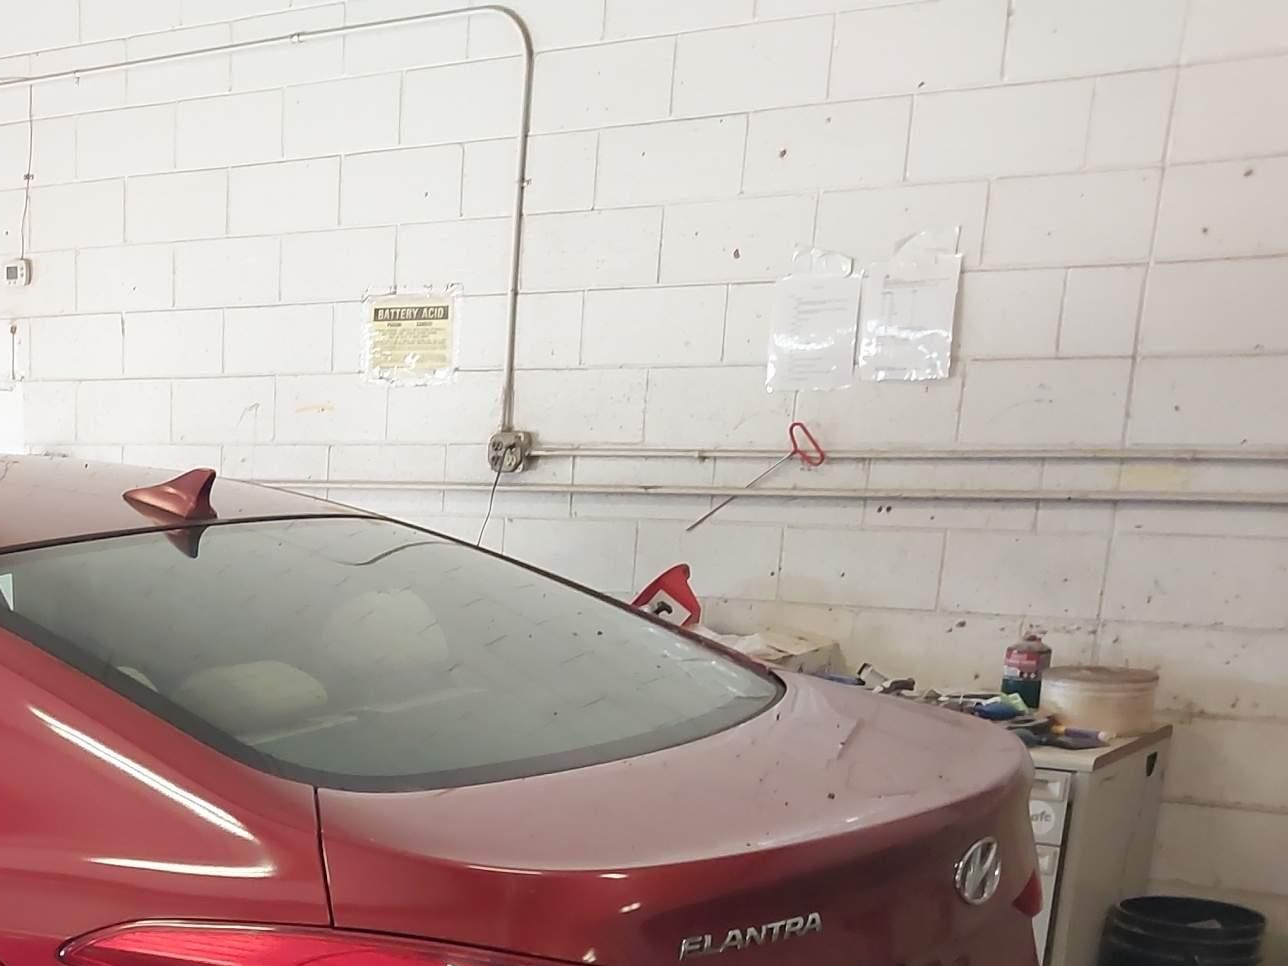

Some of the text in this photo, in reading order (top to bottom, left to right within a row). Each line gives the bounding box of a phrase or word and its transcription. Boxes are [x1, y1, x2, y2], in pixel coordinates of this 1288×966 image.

[378, 307, 444, 320] BATTERY ACID
[679, 911, 823, 961] ELANTRA
